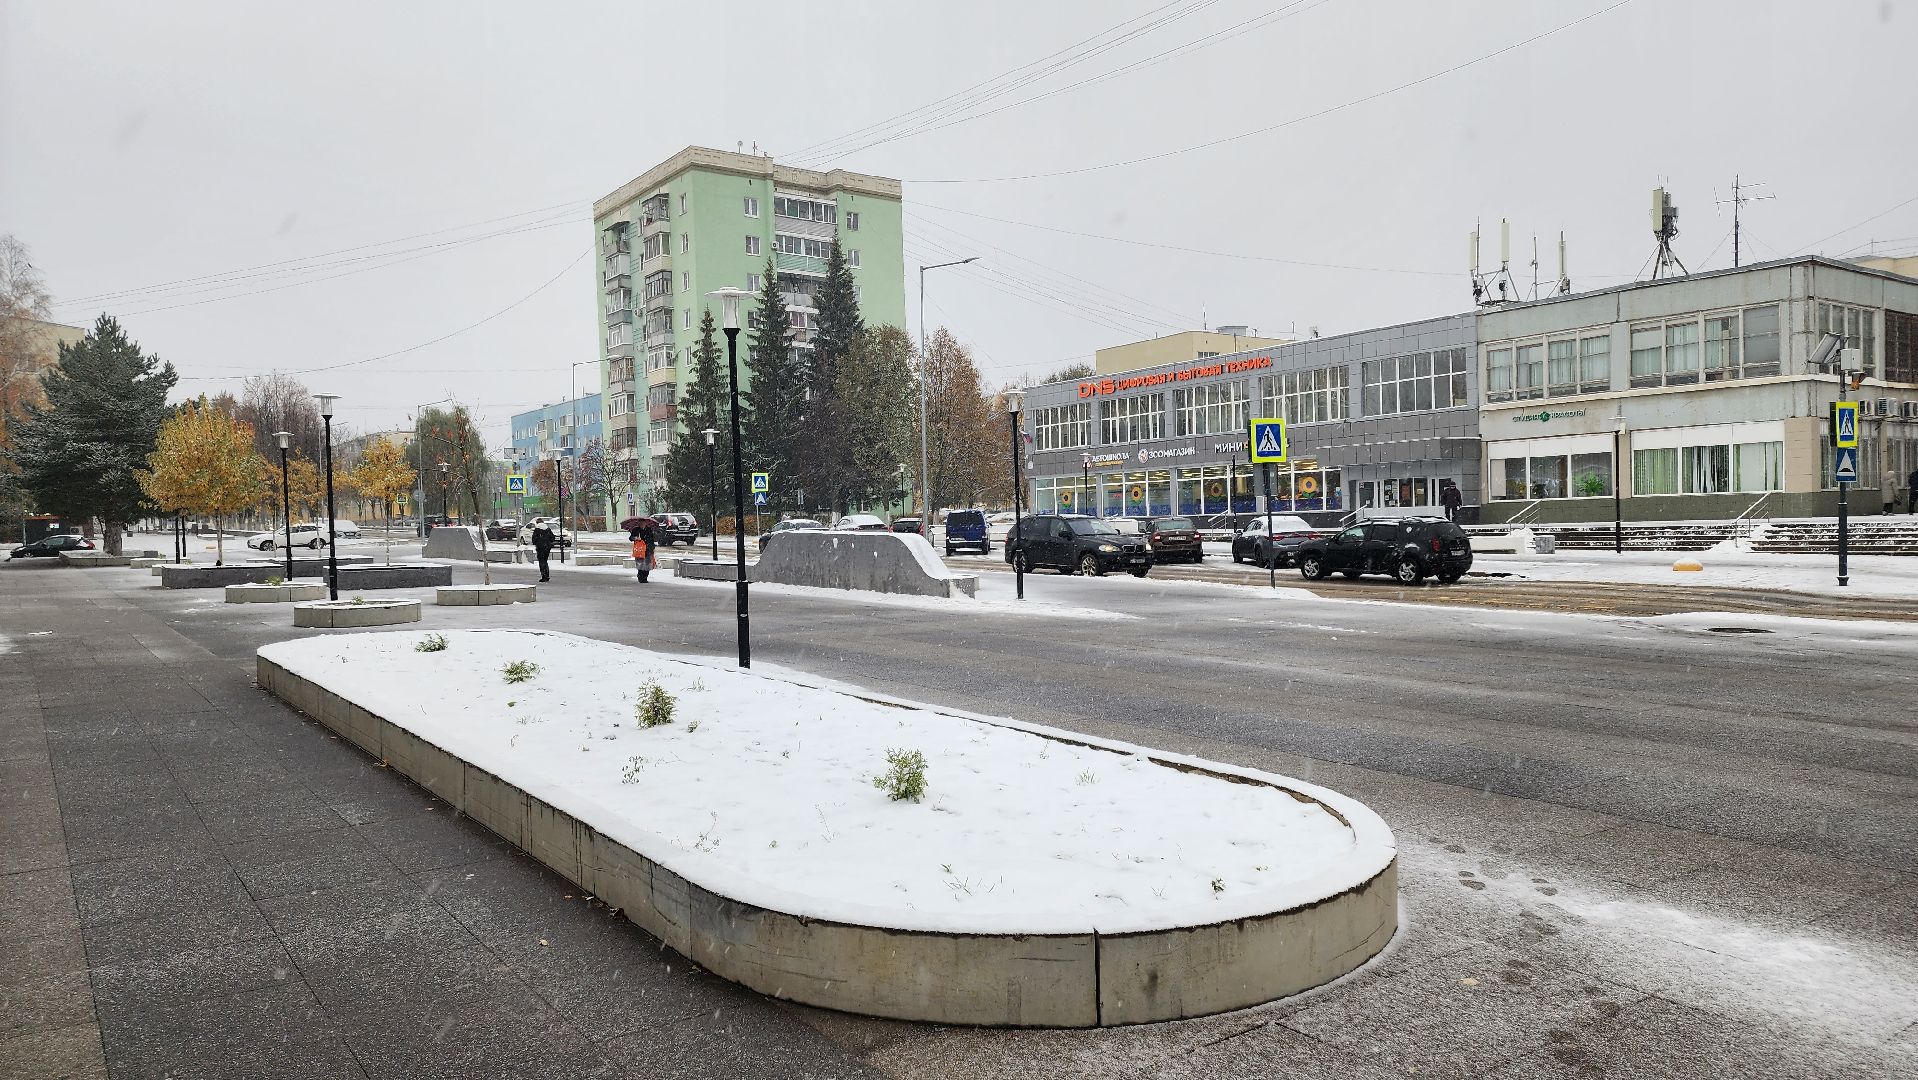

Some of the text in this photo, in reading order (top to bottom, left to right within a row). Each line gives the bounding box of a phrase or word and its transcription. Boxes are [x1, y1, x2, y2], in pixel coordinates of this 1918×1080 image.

[1117, 373, 1167, 391] ЦИФРОВАЯ
[1178, 364, 1222, 381] БЫТОВАЯ
[1227, 356, 1273, 374] ТЕХНИКА
[1078, 380, 1115, 398] DNS
[1148, 446, 1196, 459] ЗООМАГАЗИН
[1214, 441, 1243, 454] МИНИ
